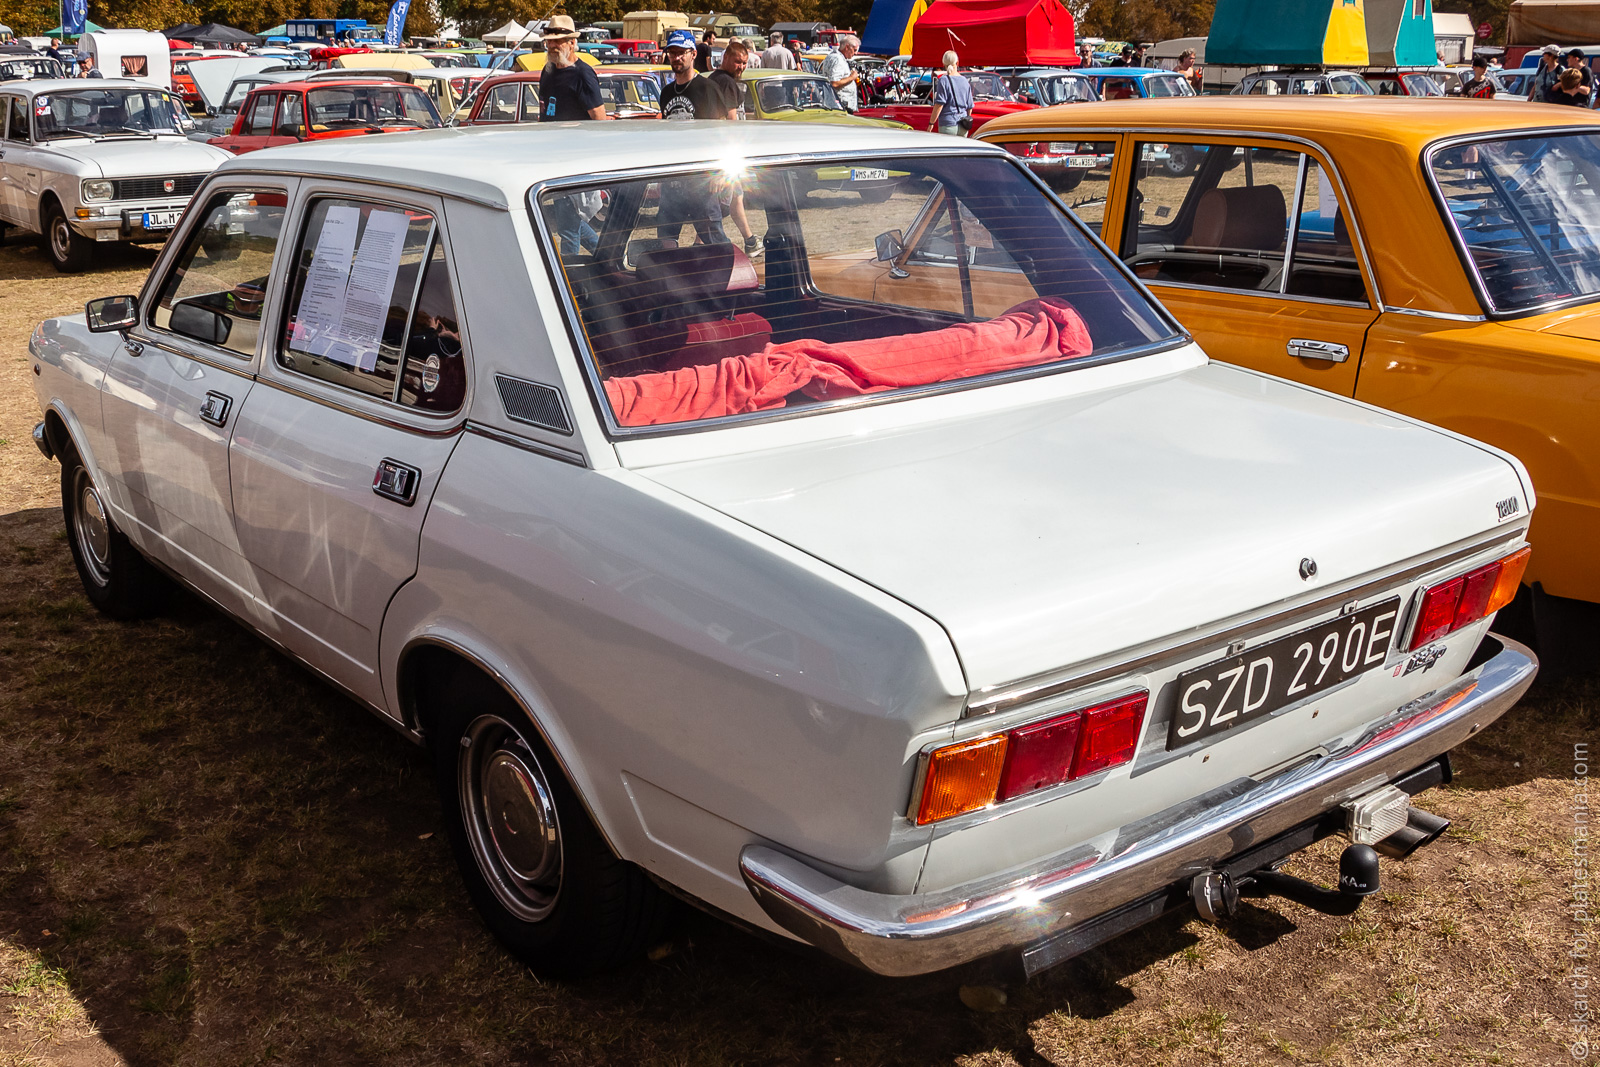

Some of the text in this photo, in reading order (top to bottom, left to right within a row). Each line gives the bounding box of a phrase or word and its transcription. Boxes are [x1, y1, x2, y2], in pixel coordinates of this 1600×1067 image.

[855, 170, 867, 180] WMS
[150, 214, 163, 225] JL
[1177, 610, 1397, 738] SZD 290E
